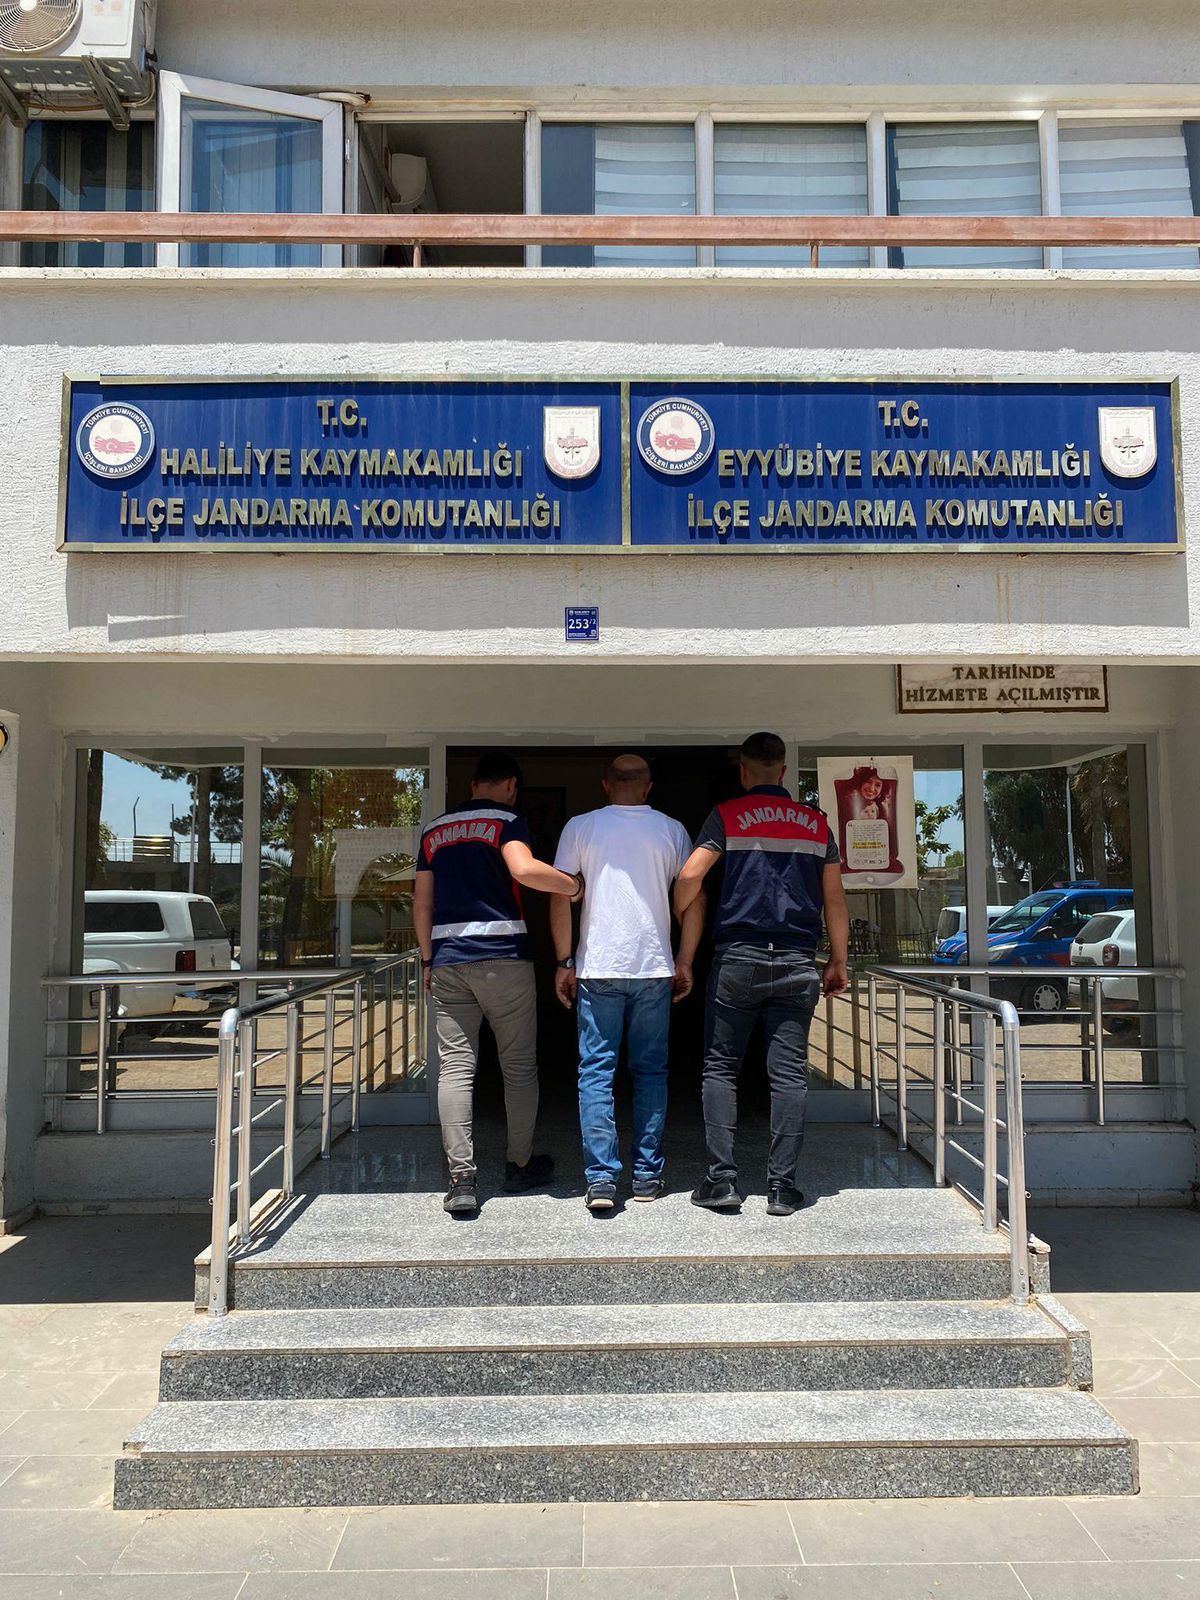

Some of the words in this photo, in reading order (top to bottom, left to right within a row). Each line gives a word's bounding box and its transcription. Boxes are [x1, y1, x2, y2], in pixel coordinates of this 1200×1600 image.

[316, 399, 368, 427] T.C.
[879, 400, 929, 428] T.C.
[160, 441, 292, 476] HALİLİYE
[300, 442, 523, 477] KAYMAKAMLIĞI
[717, 443, 862, 477] EYYÜBİYE
[872, 443, 1091, 477] KAYMAKAMLIĞI
[120, 491, 184, 532] İLÇE
[193, 499, 353, 527] JANDARMA
[361, 493, 561, 528] KOMUTANLIĞI
[687, 493, 749, 534] İLÇE
[759, 499, 917, 528] JANDARMA
[925, 493, 1123, 528] KOMUTANLIĞI
[952, 664, 1056, 680] TARİHİNDE
[905, 686, 988, 702] HİZMETE
[996, 687, 1101, 704] AÇILMIŞTIR
[736, 806, 818, 834] JANDARMA
